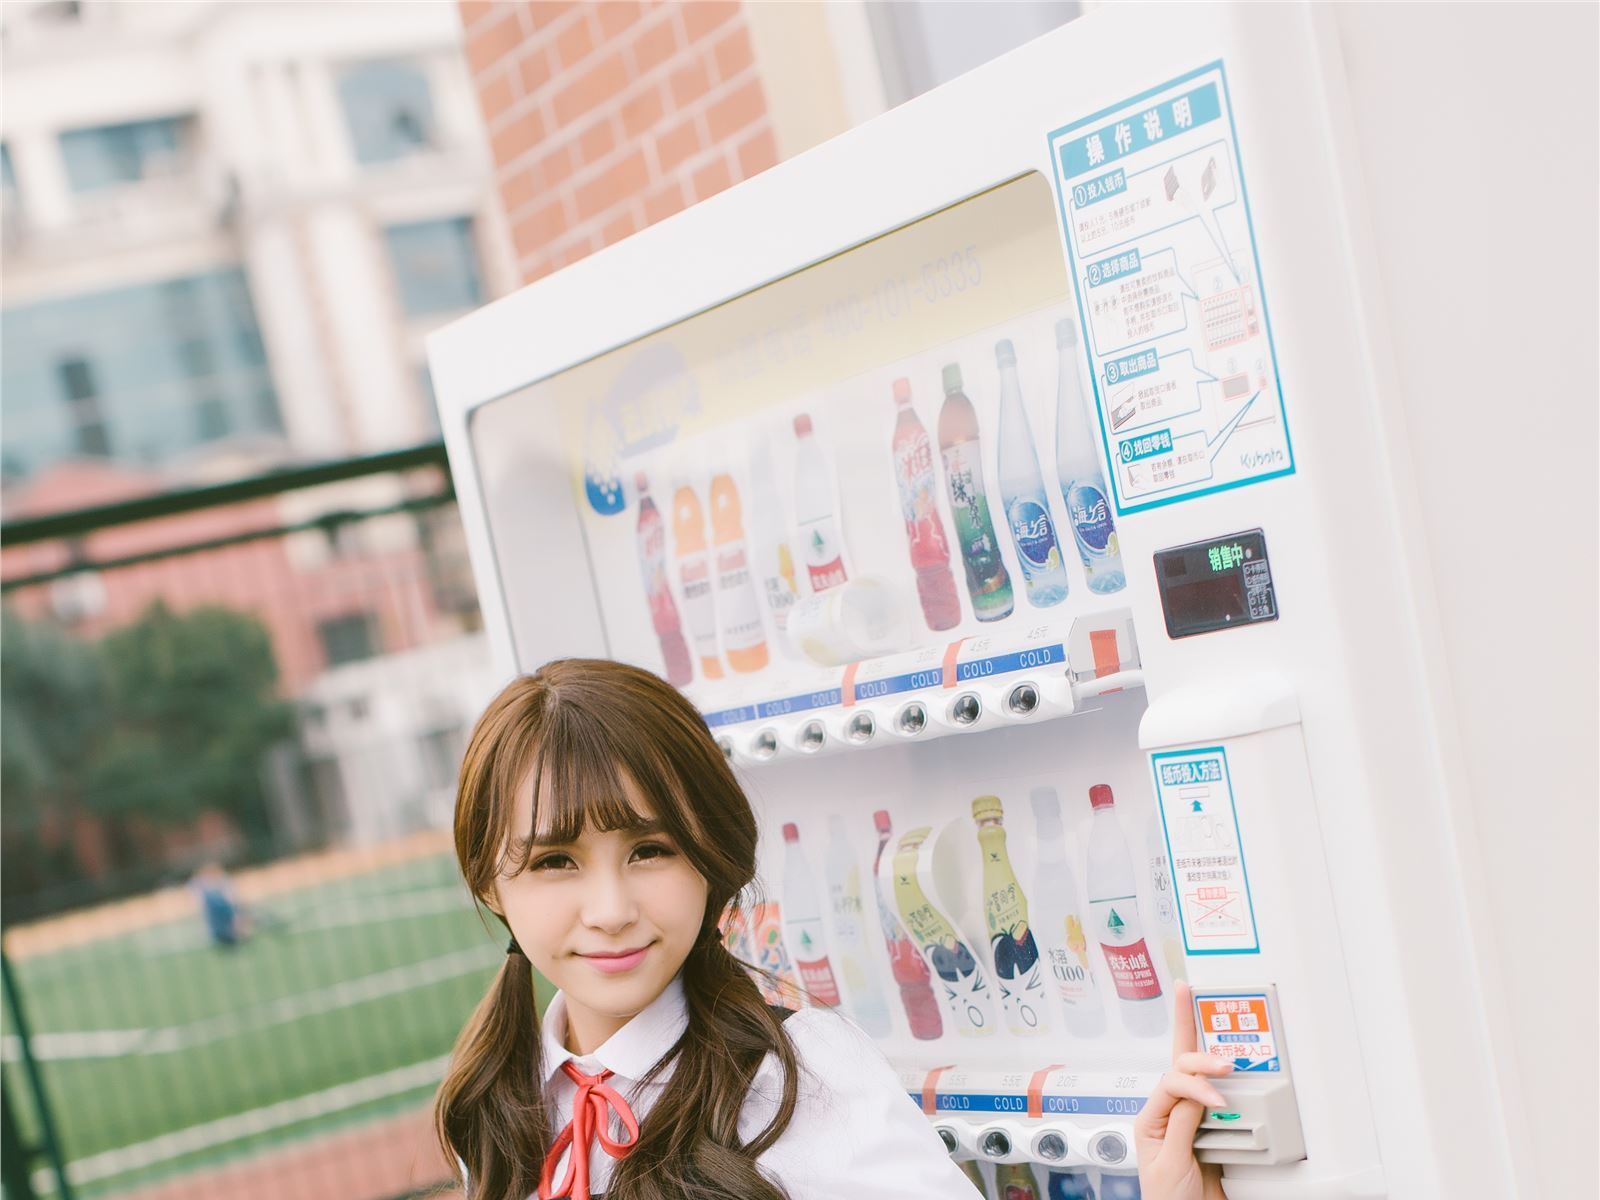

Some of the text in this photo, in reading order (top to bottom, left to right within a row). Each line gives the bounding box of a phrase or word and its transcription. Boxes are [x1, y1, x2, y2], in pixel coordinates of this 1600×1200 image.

[1085, 96, 1193, 166] 操作说明
[1208, 542, 1244, 572] 销售中
[811, 690, 838, 707] COLD
[860, 681, 888, 698] COLD
[911, 671, 940, 688] COLD
[963, 660, 993, 678] COLD
[1019, 649, 1051, 668] COLD
[1109, 952, 1150, 971] 农夫山泉
[1053, 964, 1085, 982] C100
[1209, 1044, 1273, 1057] 纸币投入口
[942, 1095, 1138, 1113] COLD COLD COLD COLD
